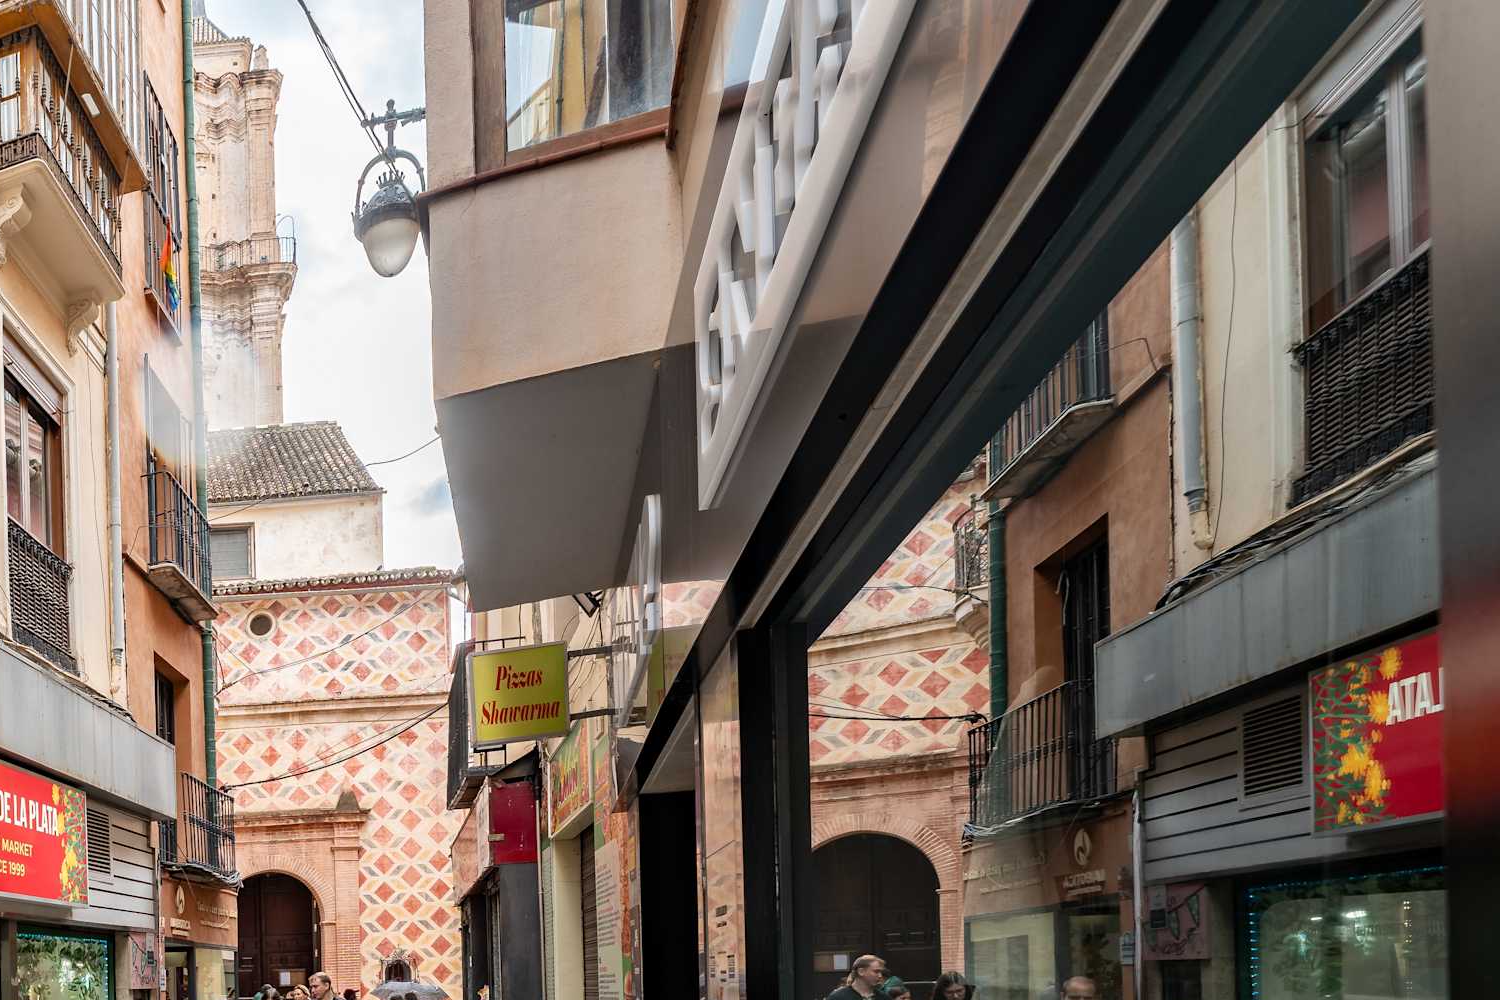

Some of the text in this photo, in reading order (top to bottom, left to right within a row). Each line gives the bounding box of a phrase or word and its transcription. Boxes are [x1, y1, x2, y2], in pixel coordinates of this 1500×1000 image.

[495, 664, 543, 691] Pizzas
[481, 700, 561, 726] Shawarma
[13, 794, 27, 829] LA
[29, 799, 59, 837] PLATA
[2, 838, 33, 857] MARKET
[9, 862, 25, 877] 1999
